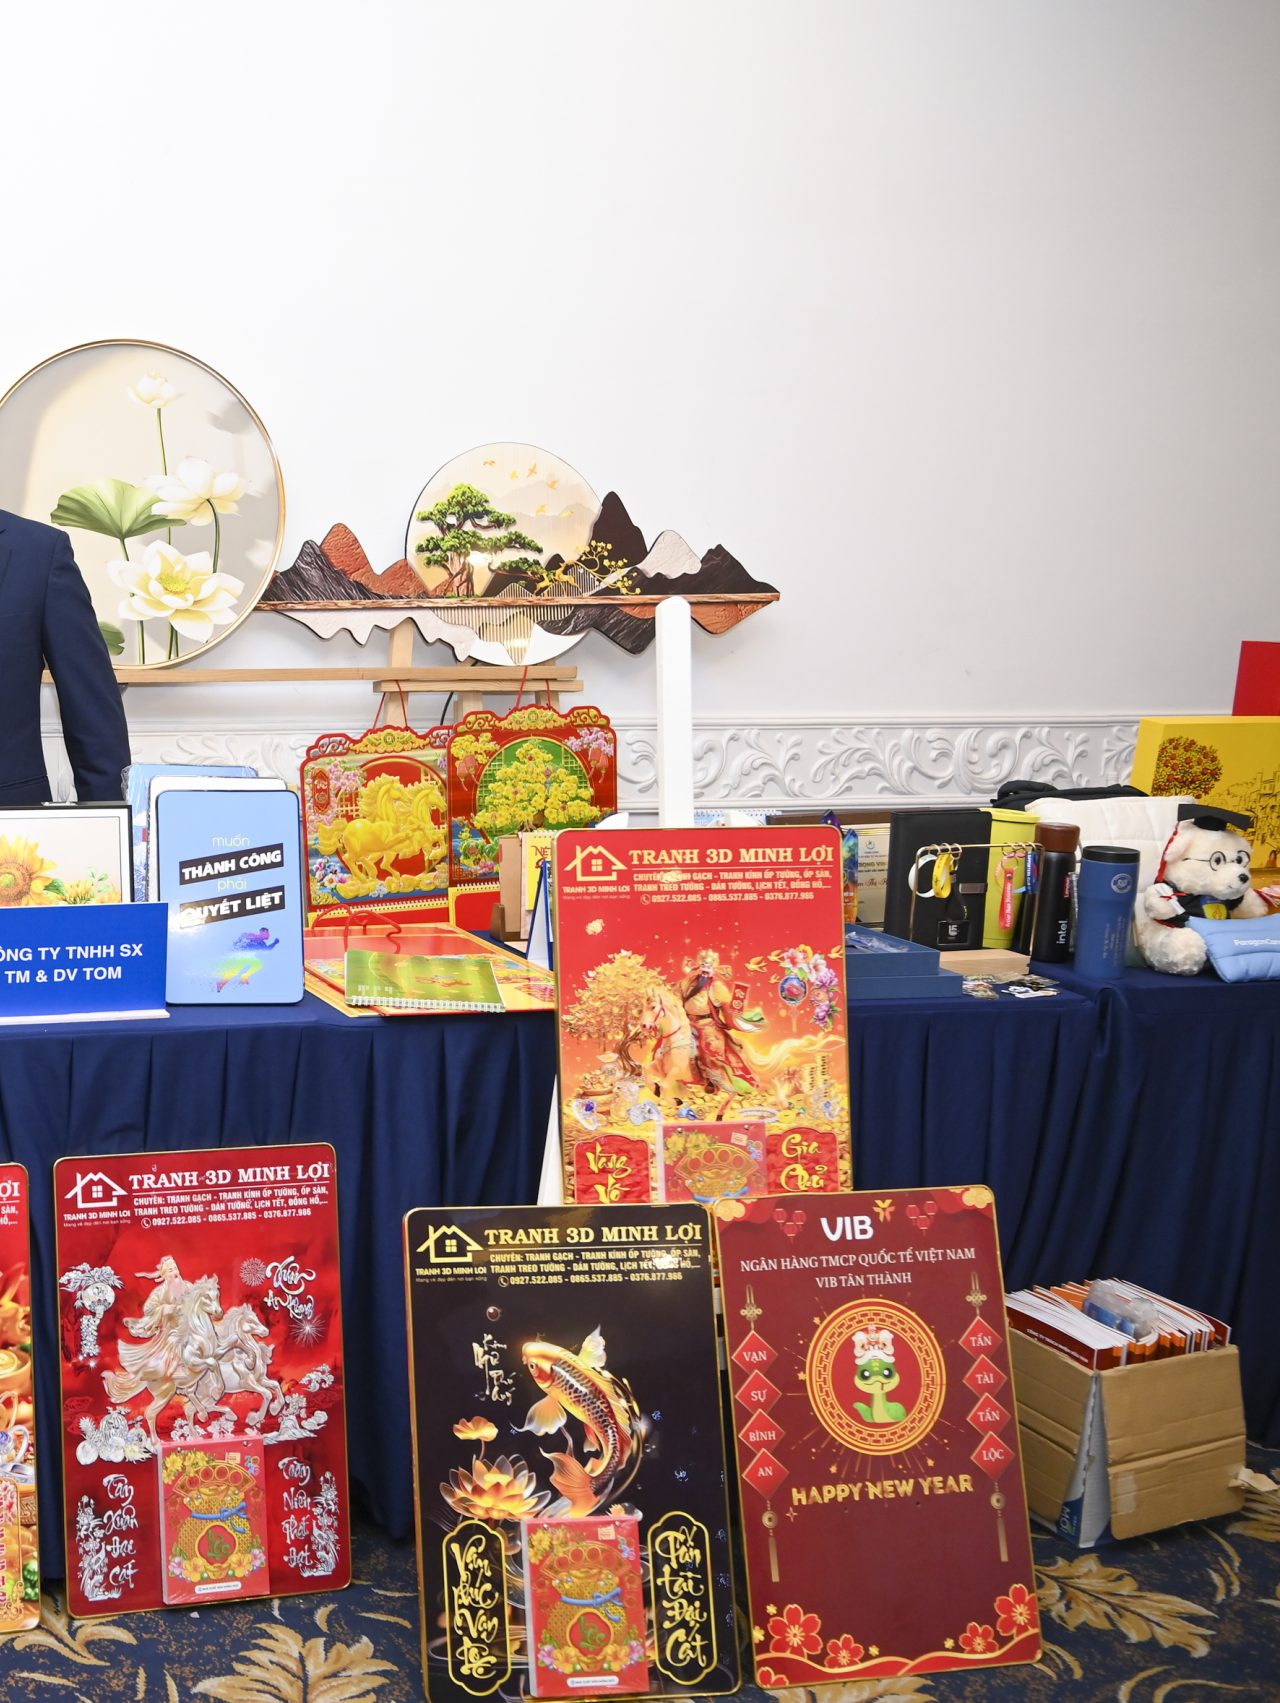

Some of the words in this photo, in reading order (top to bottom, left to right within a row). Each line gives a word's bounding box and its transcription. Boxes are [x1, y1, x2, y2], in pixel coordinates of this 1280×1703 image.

[212, 834, 250, 847] muốn
[628, 848, 700, 865] TRANH
[705, 848, 733, 864] 3D
[738, 847, 793, 864] MINH
[799, 845, 834, 866] LỢI
[181, 858, 236, 880] THÀNH
[239, 849, 283, 868] CÔNG
[217, 876, 248, 893] phải
[1056, 920, 1068, 945] intel
[37, 947, 60, 959] TY
[65, 945, 114, 959] TNHH
[119, 943, 142, 956] SX
[4, 970, 29, 983] TM
[35, 970, 47, 982] &
[53, 968, 77, 981] DV
[82, 966, 121, 980] TOM
[129, 1172, 199, 1190] TRANH
[205, 1170, 231, 1185] 3D
[238, 1166, 290, 1182] MINH
[297, 1162, 330, 1181] LỢI
[484, 1227, 559, 1245] TRANH
[566, 1227, 594, 1243] 3D
[601, 1225, 658, 1242] MINH
[665, 1222, 702, 1242] LỢI
[820, 1215, 873, 1241] VIB
[740, 1256, 777, 1271] NGÂN
[780, 1254, 820, 1269] HÀNG
[820, 1254, 856, 1267] TMCP
[858, 1248, 896, 1267] QUỐC
[897, 1247, 913, 1262] TẾ
[915, 1247, 944, 1263] VIỆT
[946, 1247, 975, 1259] NAM
[815, 1276, 837, 1288] VIB
[839, 1272, 865, 1286] TÂN
[869, 1270, 911, 1284] THÀNH
[969, 1332, 991, 1346] TẤN
[742, 1350, 768, 1363] VẠN
[975, 1372, 993, 1383] TÀI
[751, 1389, 767, 1402] SỰ
[977, 1409, 1000, 1422] TẤN
[748, 1429, 777, 1442] BÌNH
[982, 1448, 1004, 1461] LỘC
[758, 1466, 772, 1476] AN
[792, 1482, 863, 1505] HAPPY
[865, 1478, 915, 1499] NEW
[918, 1474, 973, 1495] YEAR
